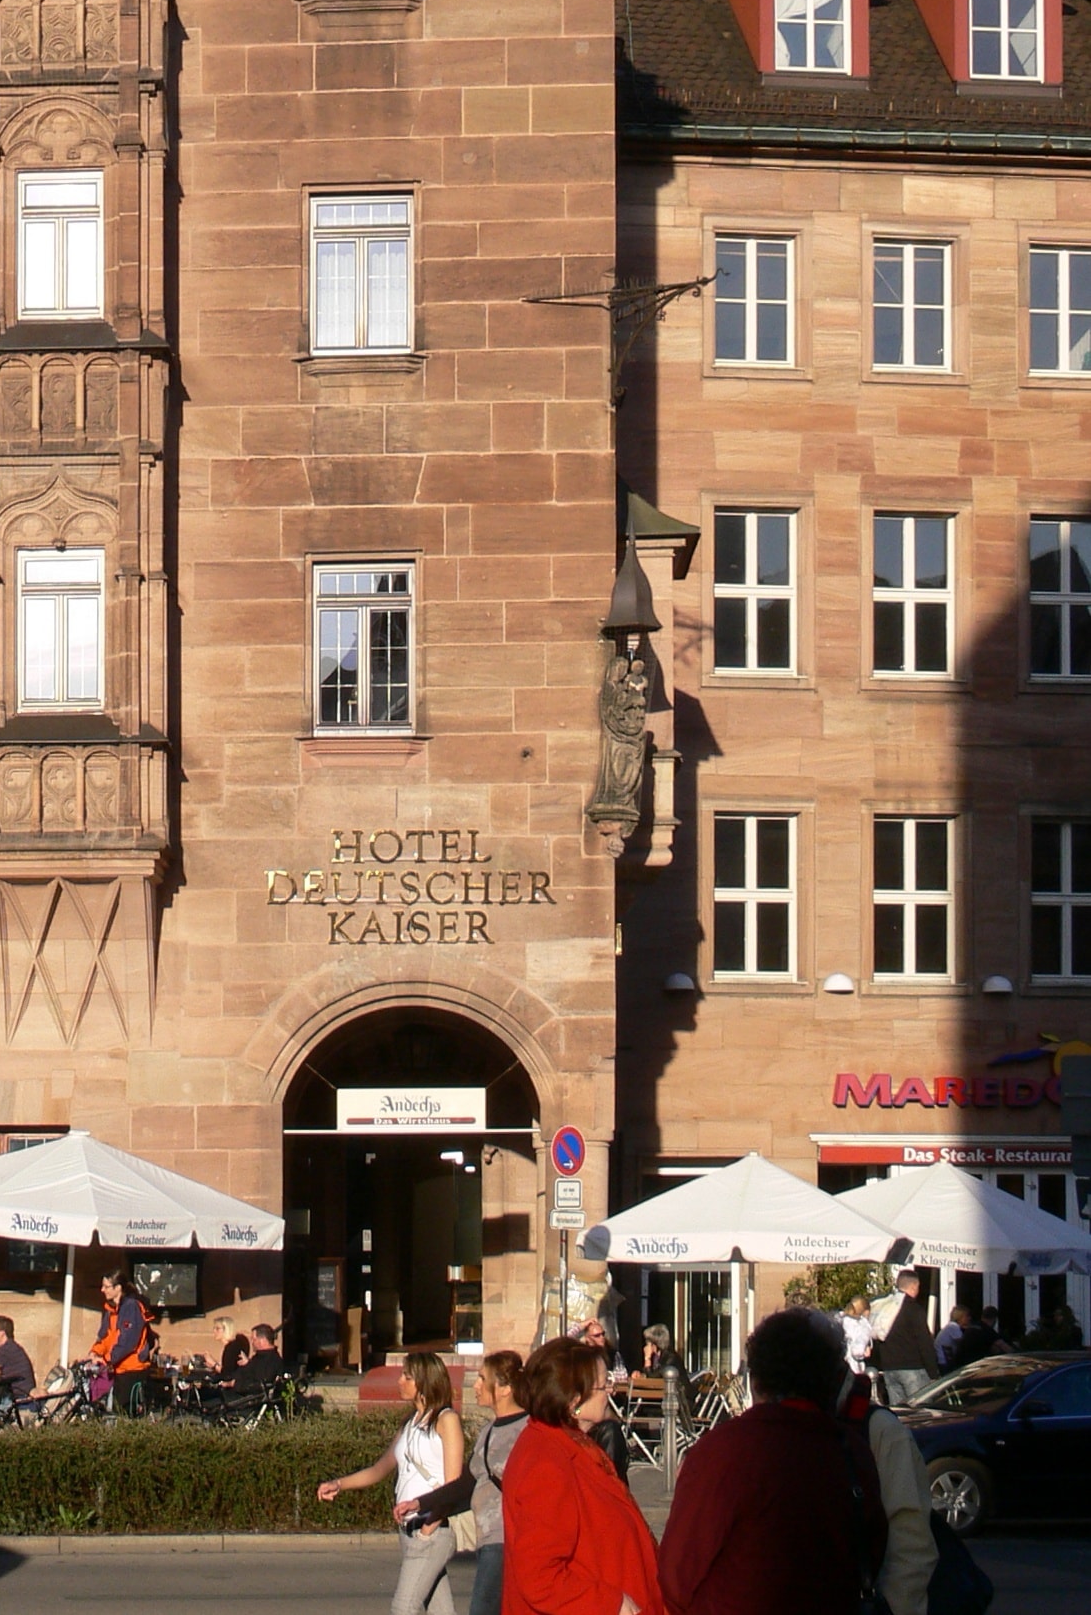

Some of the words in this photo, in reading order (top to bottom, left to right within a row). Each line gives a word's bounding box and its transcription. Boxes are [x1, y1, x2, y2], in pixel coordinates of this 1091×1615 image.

[330, 829, 492, 864] HOTEL
[264, 869, 557, 905] DEUTSCHER
[327, 911, 495, 945] KAISER
[380, 1095, 442, 1118] Andechs
[373, 1117, 393, 1125] Das
[396, 1117, 452, 1125] Wirtshaus
[902, 1147, 935, 1162] Das
[10, 1212, 59, 1238] Andechs
[126, 1219, 167, 1230] Andechser
[125, 1234, 166, 1245] Klosterbier
[221, 1223, 258, 1246] Andechs
[783, 1236, 851, 1248] Andechser
[626, 1237, 689, 1259] Andechs
[920, 1242, 977, 1256] Andechser
[920, 1255, 977, 1270] Klosterbier
